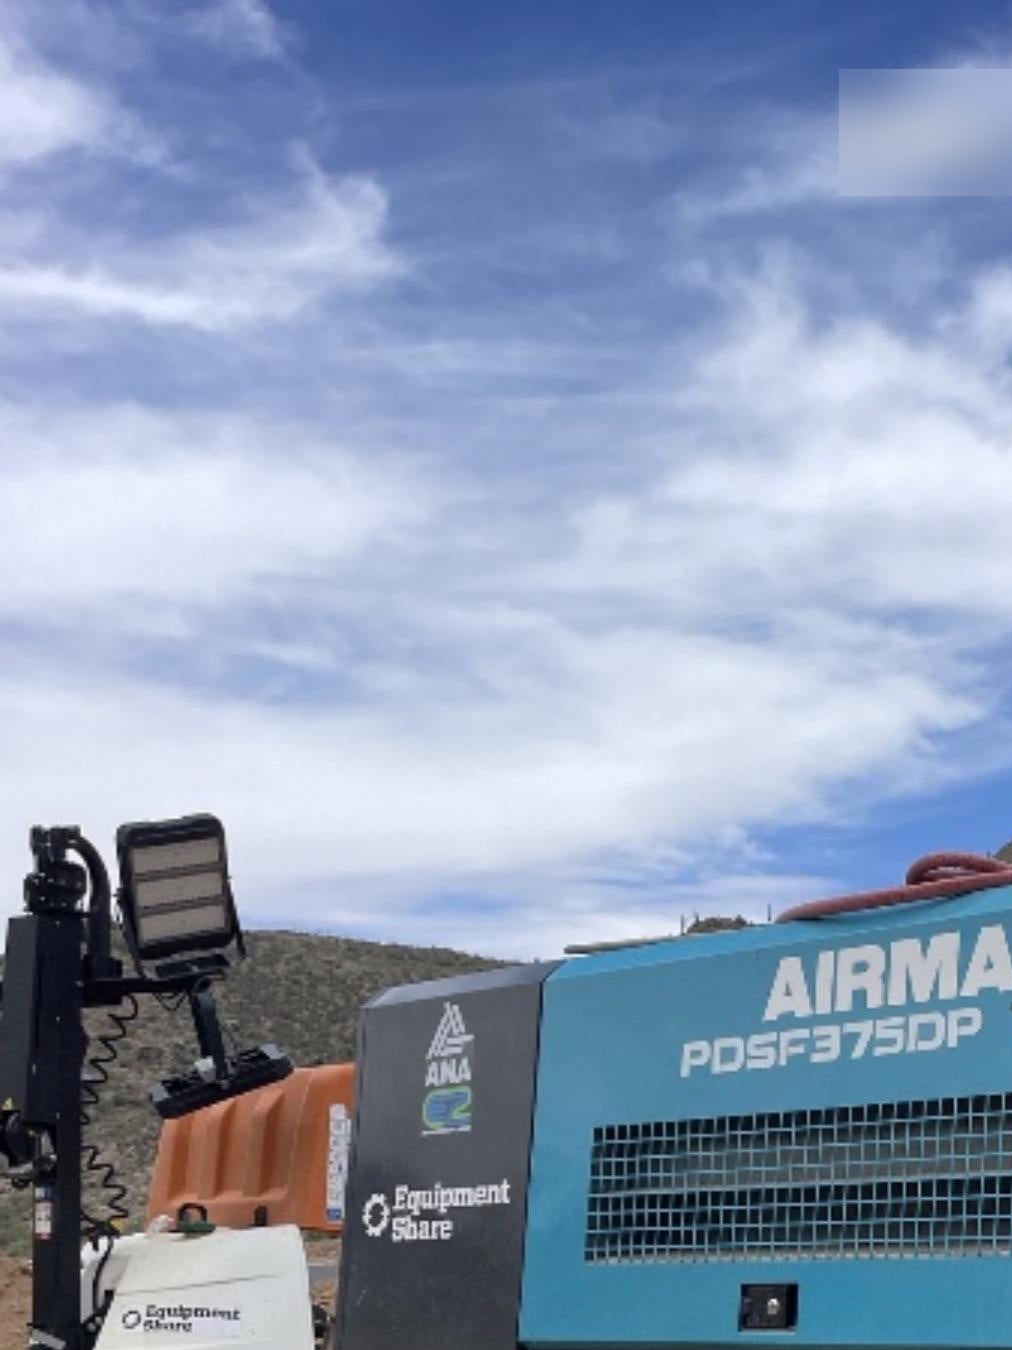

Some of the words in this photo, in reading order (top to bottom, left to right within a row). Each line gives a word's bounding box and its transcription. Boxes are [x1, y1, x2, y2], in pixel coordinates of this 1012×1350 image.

[679, 1007, 983, 1078] PDSF375DP
[425, 1057, 472, 1087] ANA
[392, 1179, 511, 1216] Equipment
[391, 1216, 453, 1242] Share
[145, 1304, 241, 1321] Equipment
